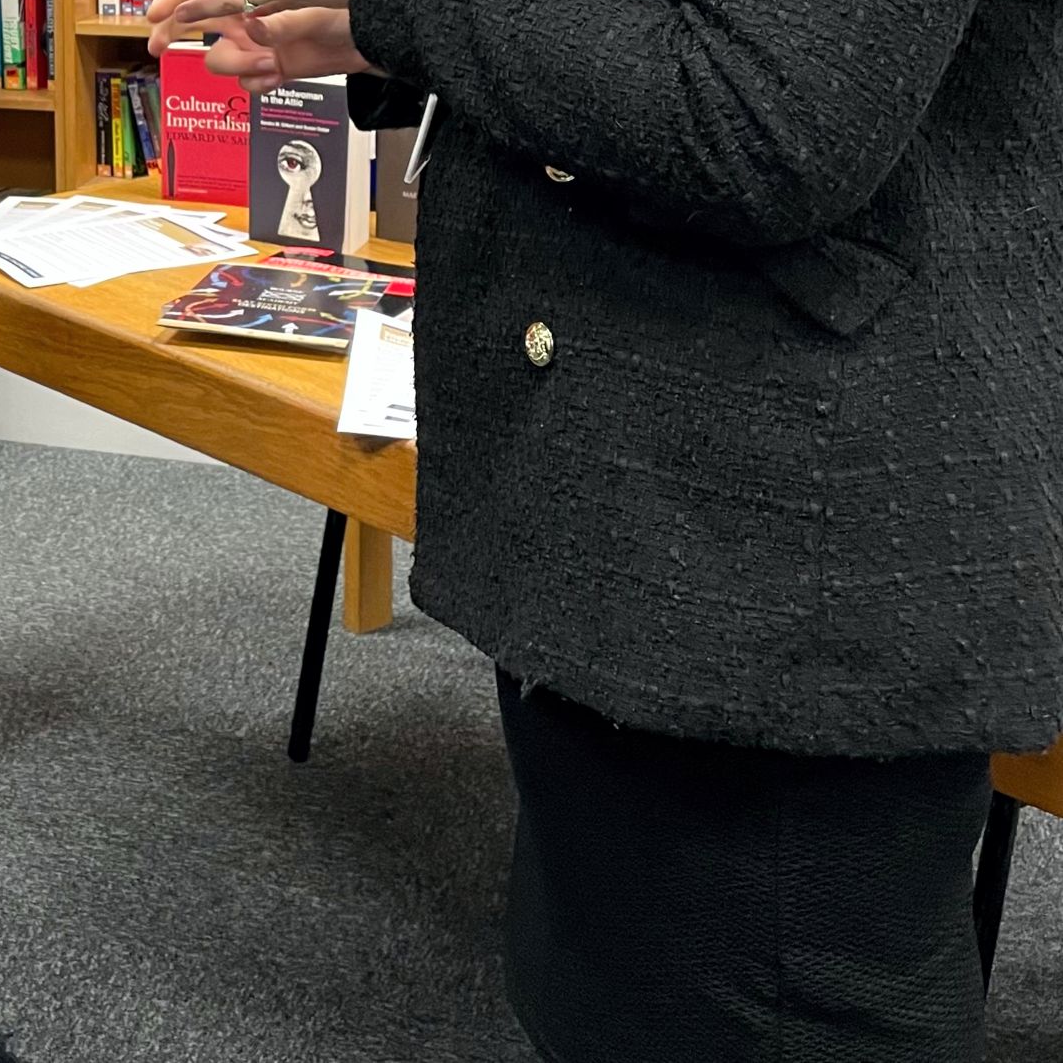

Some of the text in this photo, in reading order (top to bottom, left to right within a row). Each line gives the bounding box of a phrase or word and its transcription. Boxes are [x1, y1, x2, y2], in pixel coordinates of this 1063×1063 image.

[277, 87, 324, 101] Madwoman
[166, 95, 226, 114] Culture
[270, 95, 284, 105] the
[284, 97, 304, 108] Attic
[166, 132, 215, 143] EDWARD
[230, 136, 248, 146] SAI
